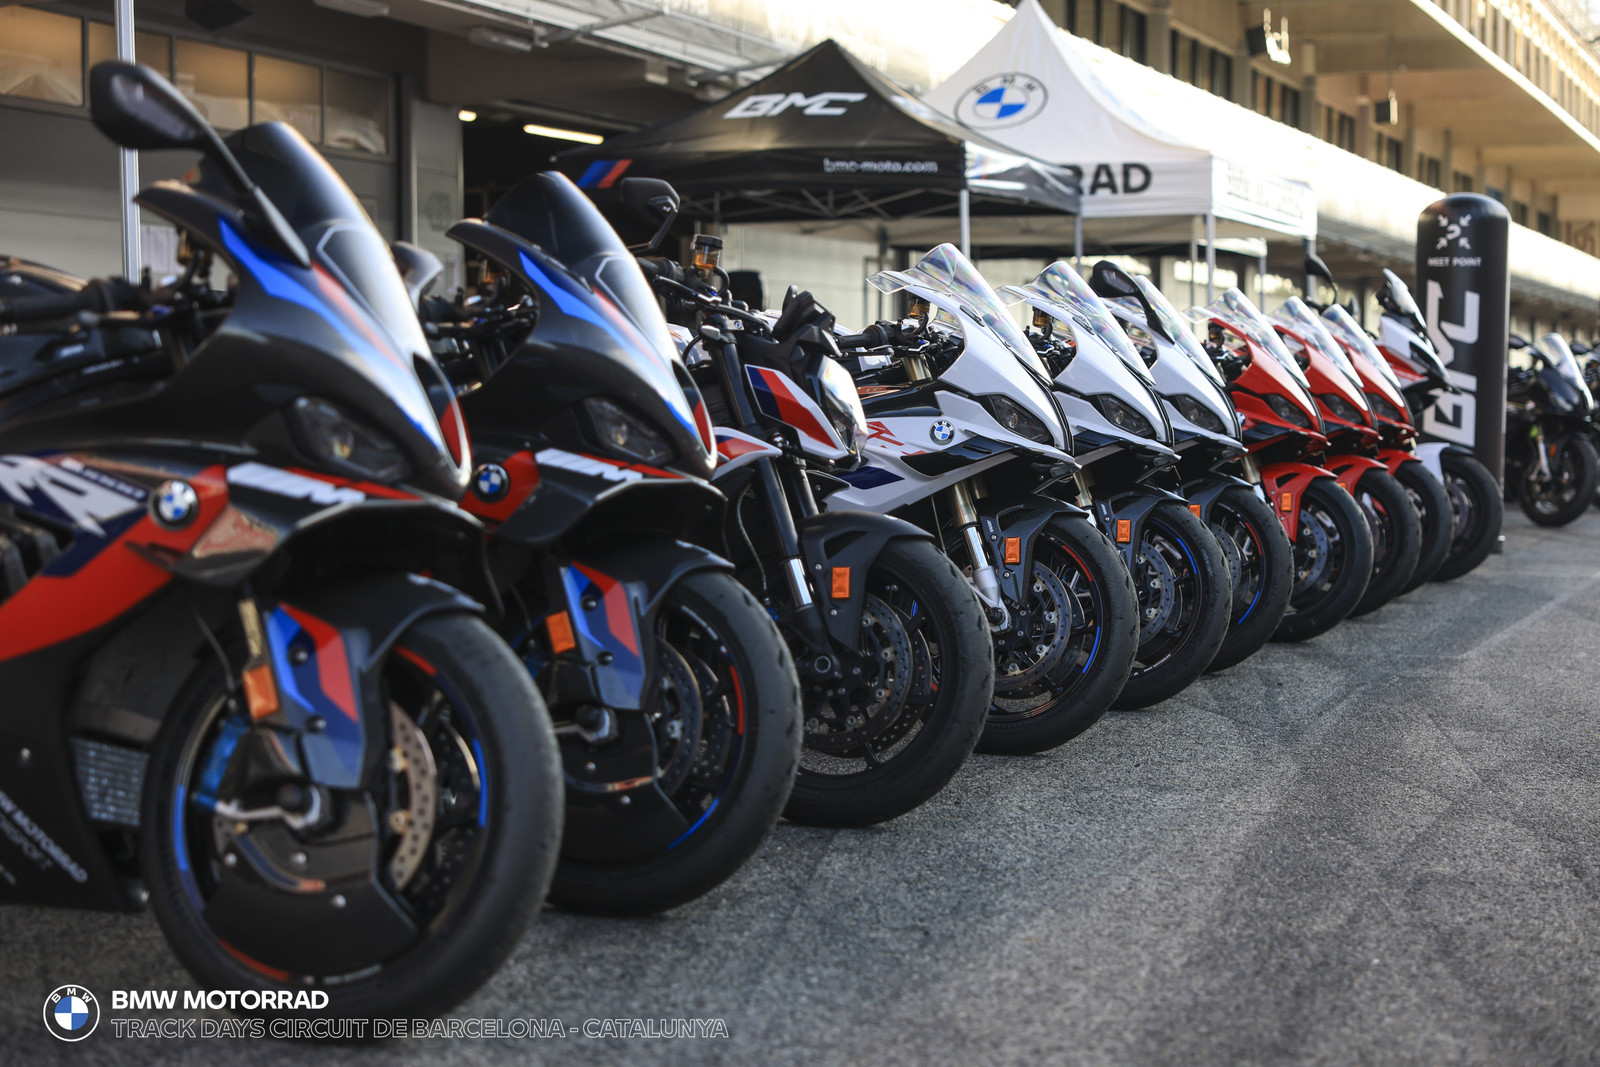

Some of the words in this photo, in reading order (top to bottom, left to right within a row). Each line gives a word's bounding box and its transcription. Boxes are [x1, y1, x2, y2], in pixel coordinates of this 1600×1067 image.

[722, 91, 868, 119] BMC
[823, 157, 938, 173] bmc-moto.com
[1428, 256, 1450, 267] MEET
[1452, 256, 1482, 267] POINT
[1423, 279, 1480, 447] BMC
[12, 808, 88, 884] MOTORRAD
